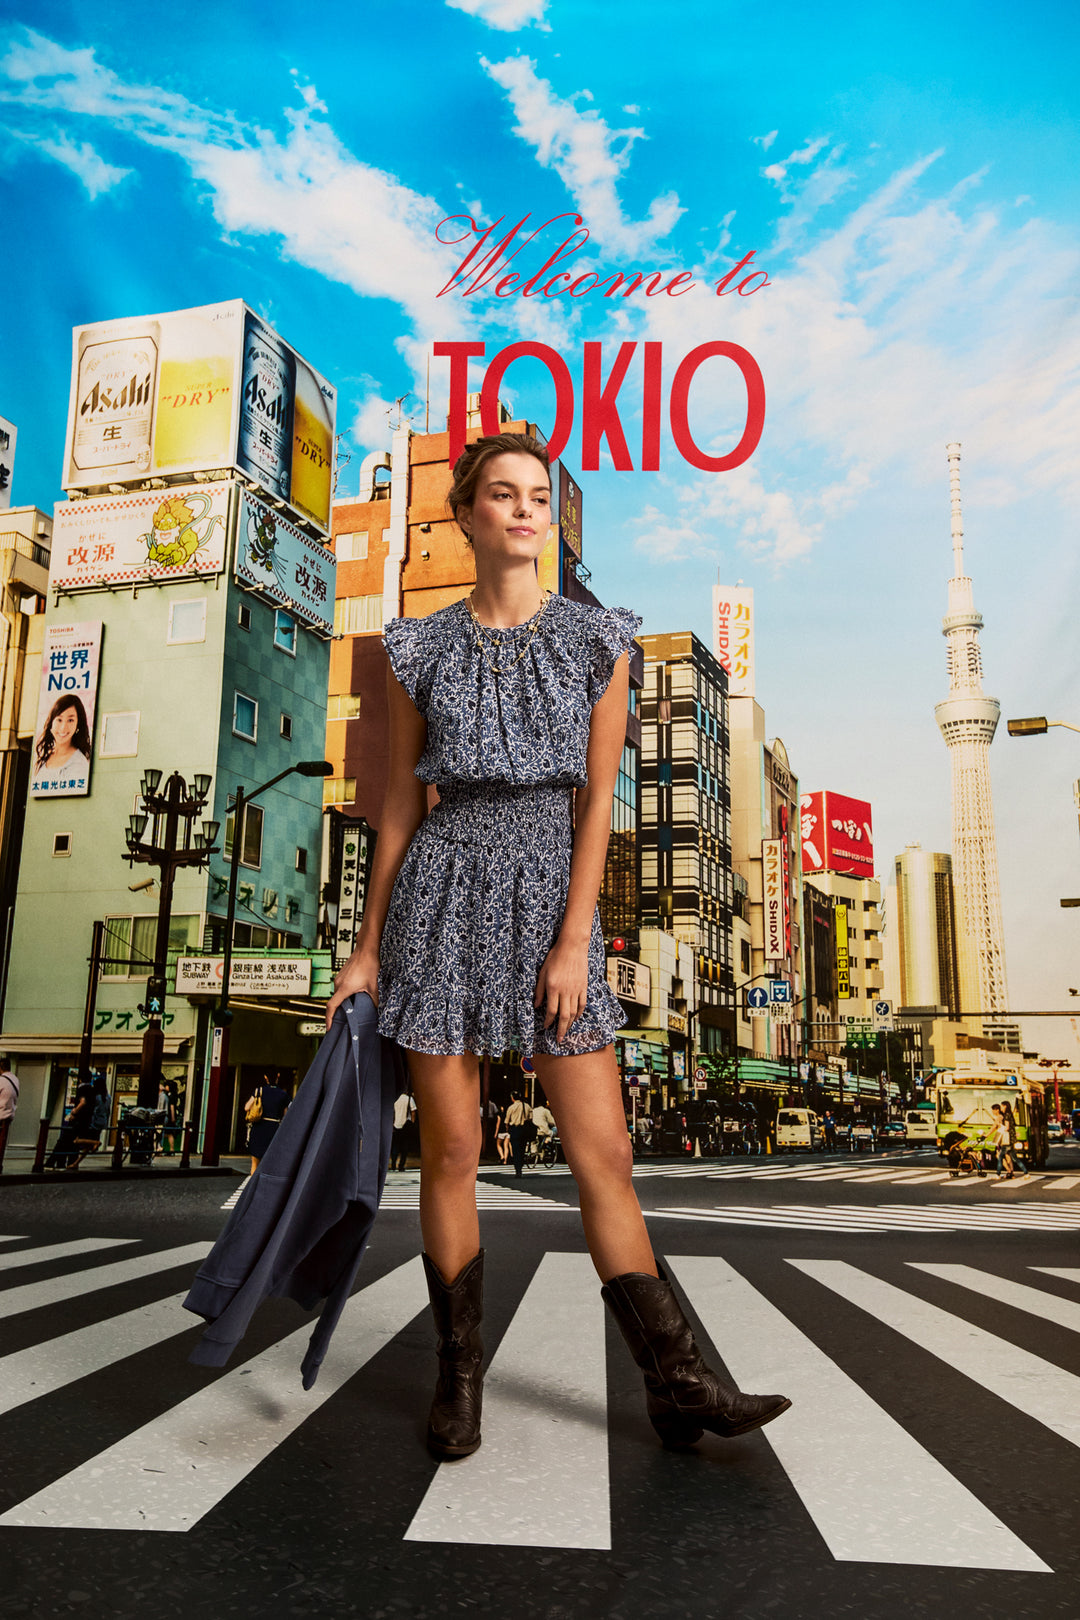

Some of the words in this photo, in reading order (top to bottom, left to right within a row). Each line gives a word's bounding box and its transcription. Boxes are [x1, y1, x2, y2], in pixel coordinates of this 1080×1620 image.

[81, 372, 151, 416] Asahi
[245, 374, 289, 432] Asah
[103, 425, 122, 442] 生
[259, 429, 272, 450] 生
[67, 542, 116, 566] 改源
[295, 562, 327, 602] 改源
[733, 602, 752, 680] カラオケ
[49, 649, 89, 672] 世界
[48, 670, 90, 692] No.1
[32, 778, 85, 791] 太陽光は東芝
[766, 844, 779, 898] カラオケ
[768, 900, 780, 954] SHIDAX
[181, 962, 212, 973] 地下鉄
[233, 963, 263, 973] 銀座線
[267, 963, 298, 973] 浅草駅
[295, 973, 308, 981] Sta.
